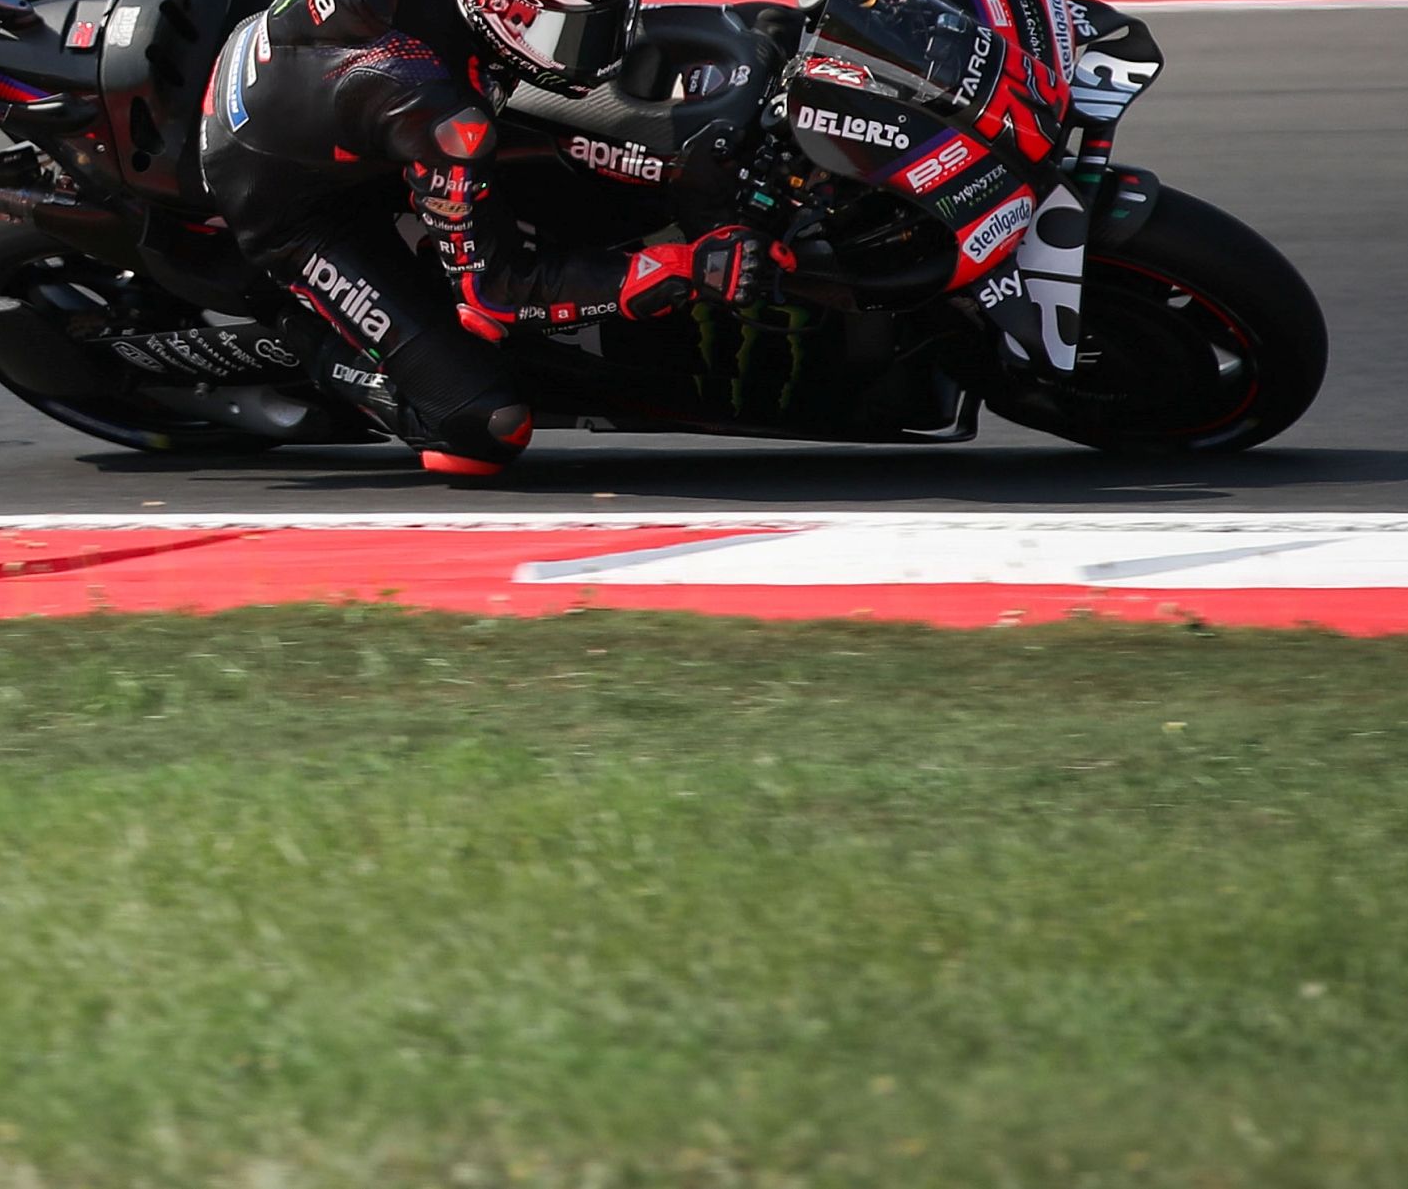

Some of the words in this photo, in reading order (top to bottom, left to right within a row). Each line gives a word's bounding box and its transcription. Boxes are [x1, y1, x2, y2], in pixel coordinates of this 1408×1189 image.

[1066, 0, 1099, 38] sky
[952, 25, 994, 107] TARGA
[569, 135, 664, 182] aprilia
[905, 139, 970, 190] BS
[951, 163, 1008, 206] MONSTER
[968, 197, 1033, 258] sterilgarda
[978, 269, 1024, 309] sky
